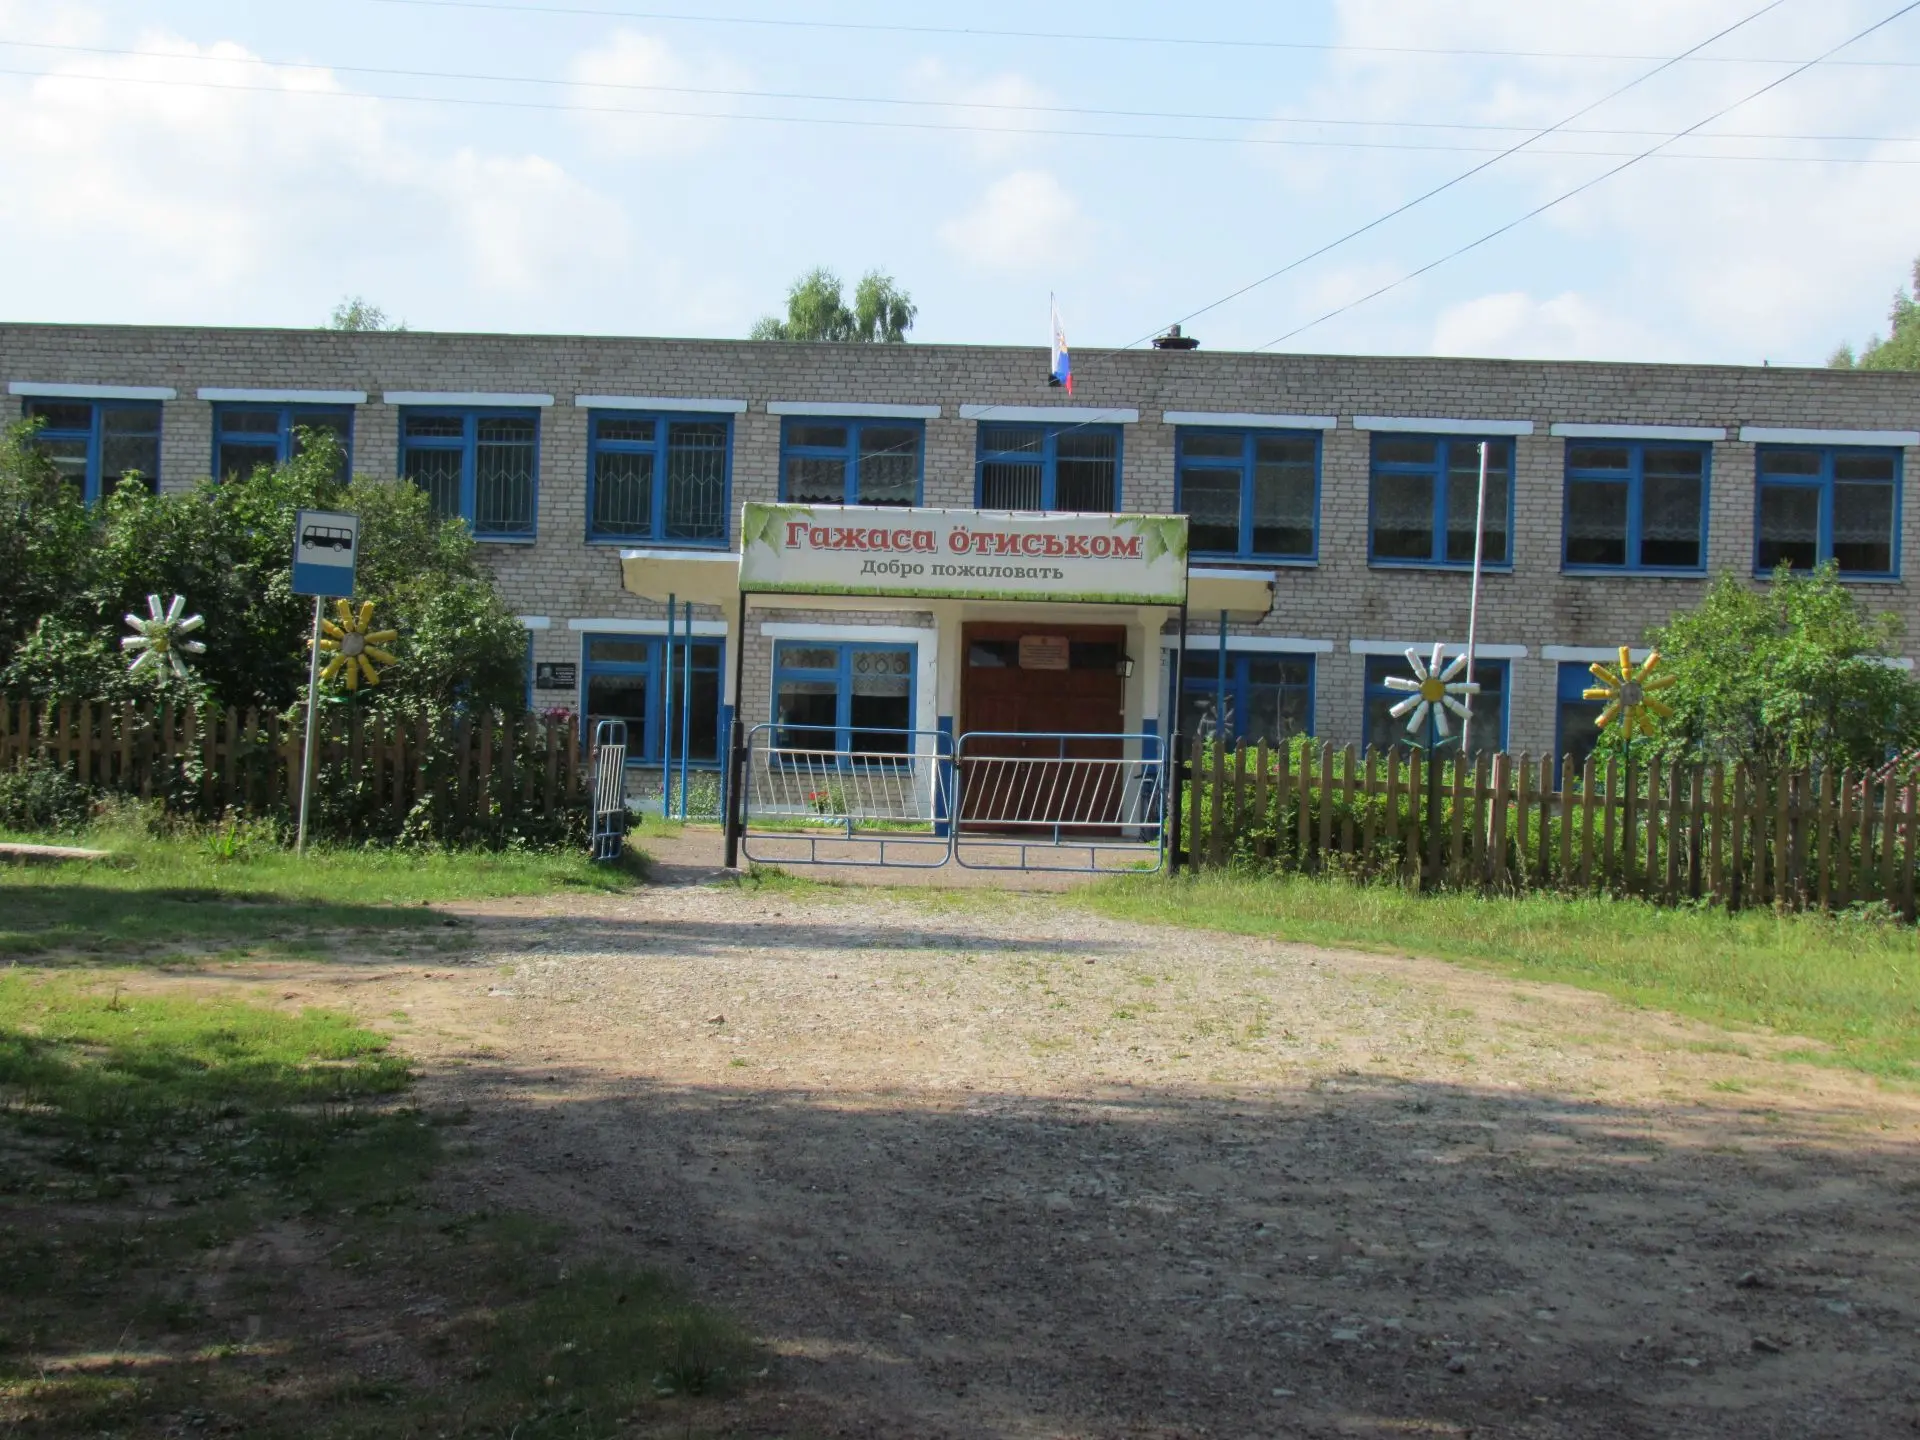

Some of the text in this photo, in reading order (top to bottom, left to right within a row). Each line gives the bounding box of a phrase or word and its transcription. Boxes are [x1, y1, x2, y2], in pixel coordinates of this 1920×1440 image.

[785, 522, 937, 553] Гажаса
[860, 559, 1064, 580] Добро пожаловать
